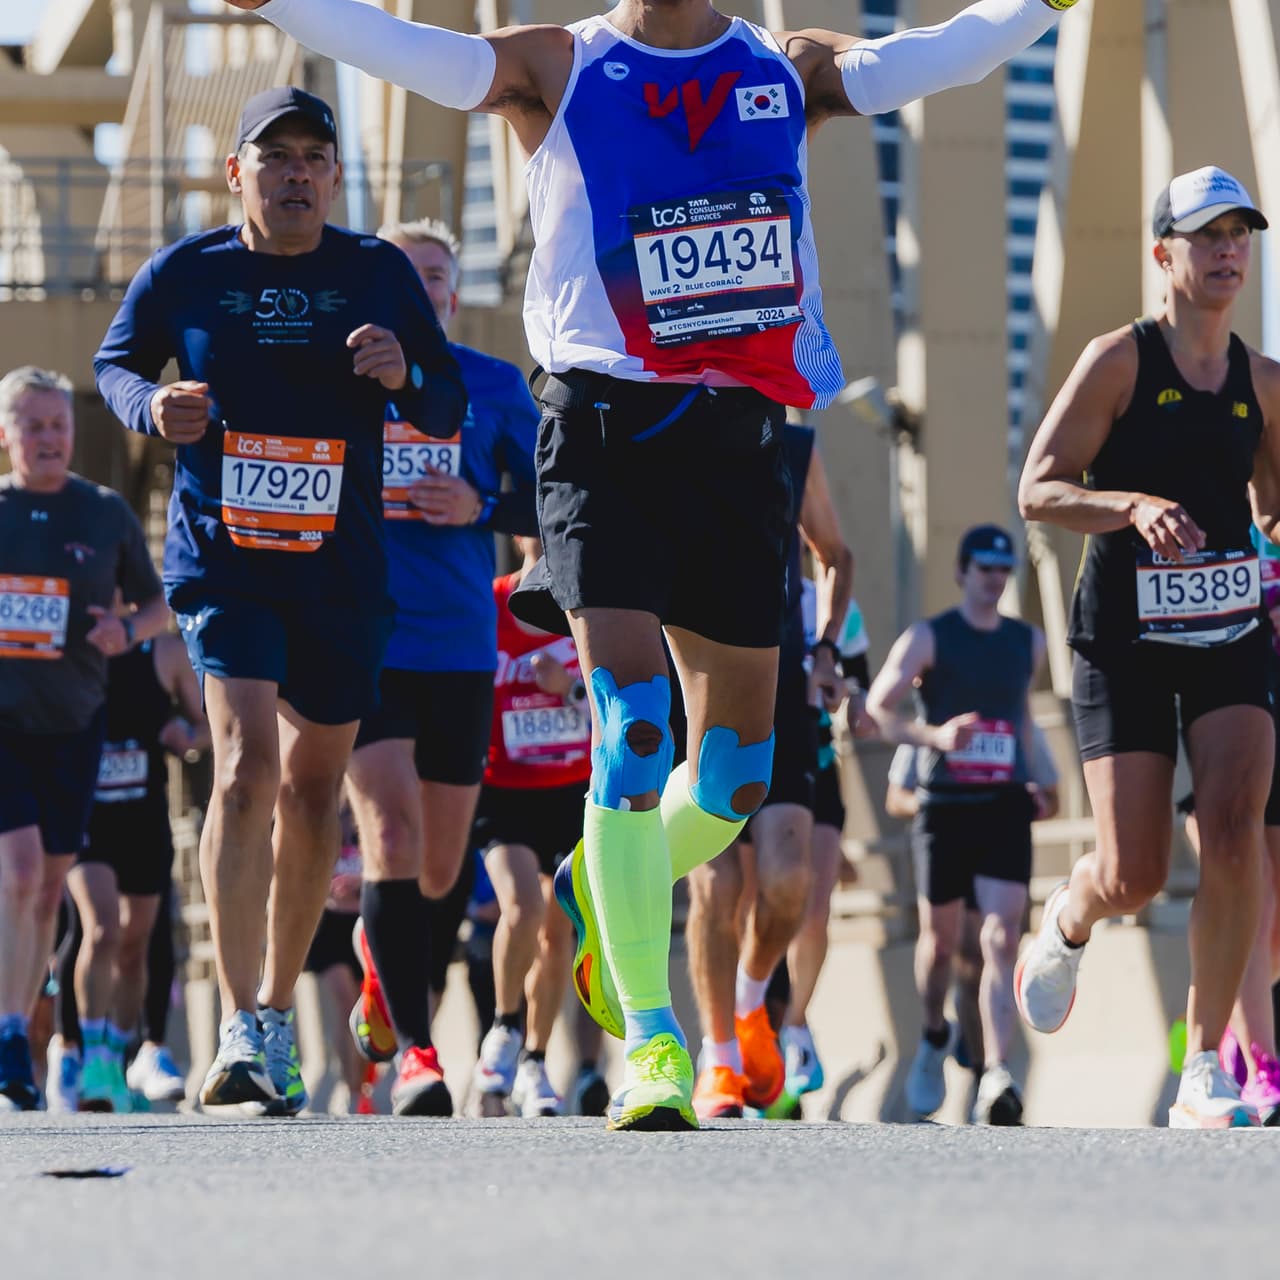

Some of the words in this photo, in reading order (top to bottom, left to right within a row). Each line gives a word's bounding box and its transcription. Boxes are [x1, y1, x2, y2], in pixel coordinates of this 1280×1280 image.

[651, 207, 687, 228] tcs
[689, 202, 737, 215] CONSULTANCY
[688, 199, 709, 207] TATA
[748, 206, 773, 215] TATA
[690, 212, 722, 222] SERVICES
[649, 225, 782, 283] 19434
[649, 287, 672, 297] WAVE
[672, 284, 681, 294] 2
[685, 283, 704, 291] BLUE
[705, 278, 735, 289] CORRAL
[735, 275, 743, 285] C
[756, 309, 785, 321] 2024
[237, 436, 264, 455] tcs
[232, 462, 331, 501] 17920
[1148, 565, 1251, 605] 15389
